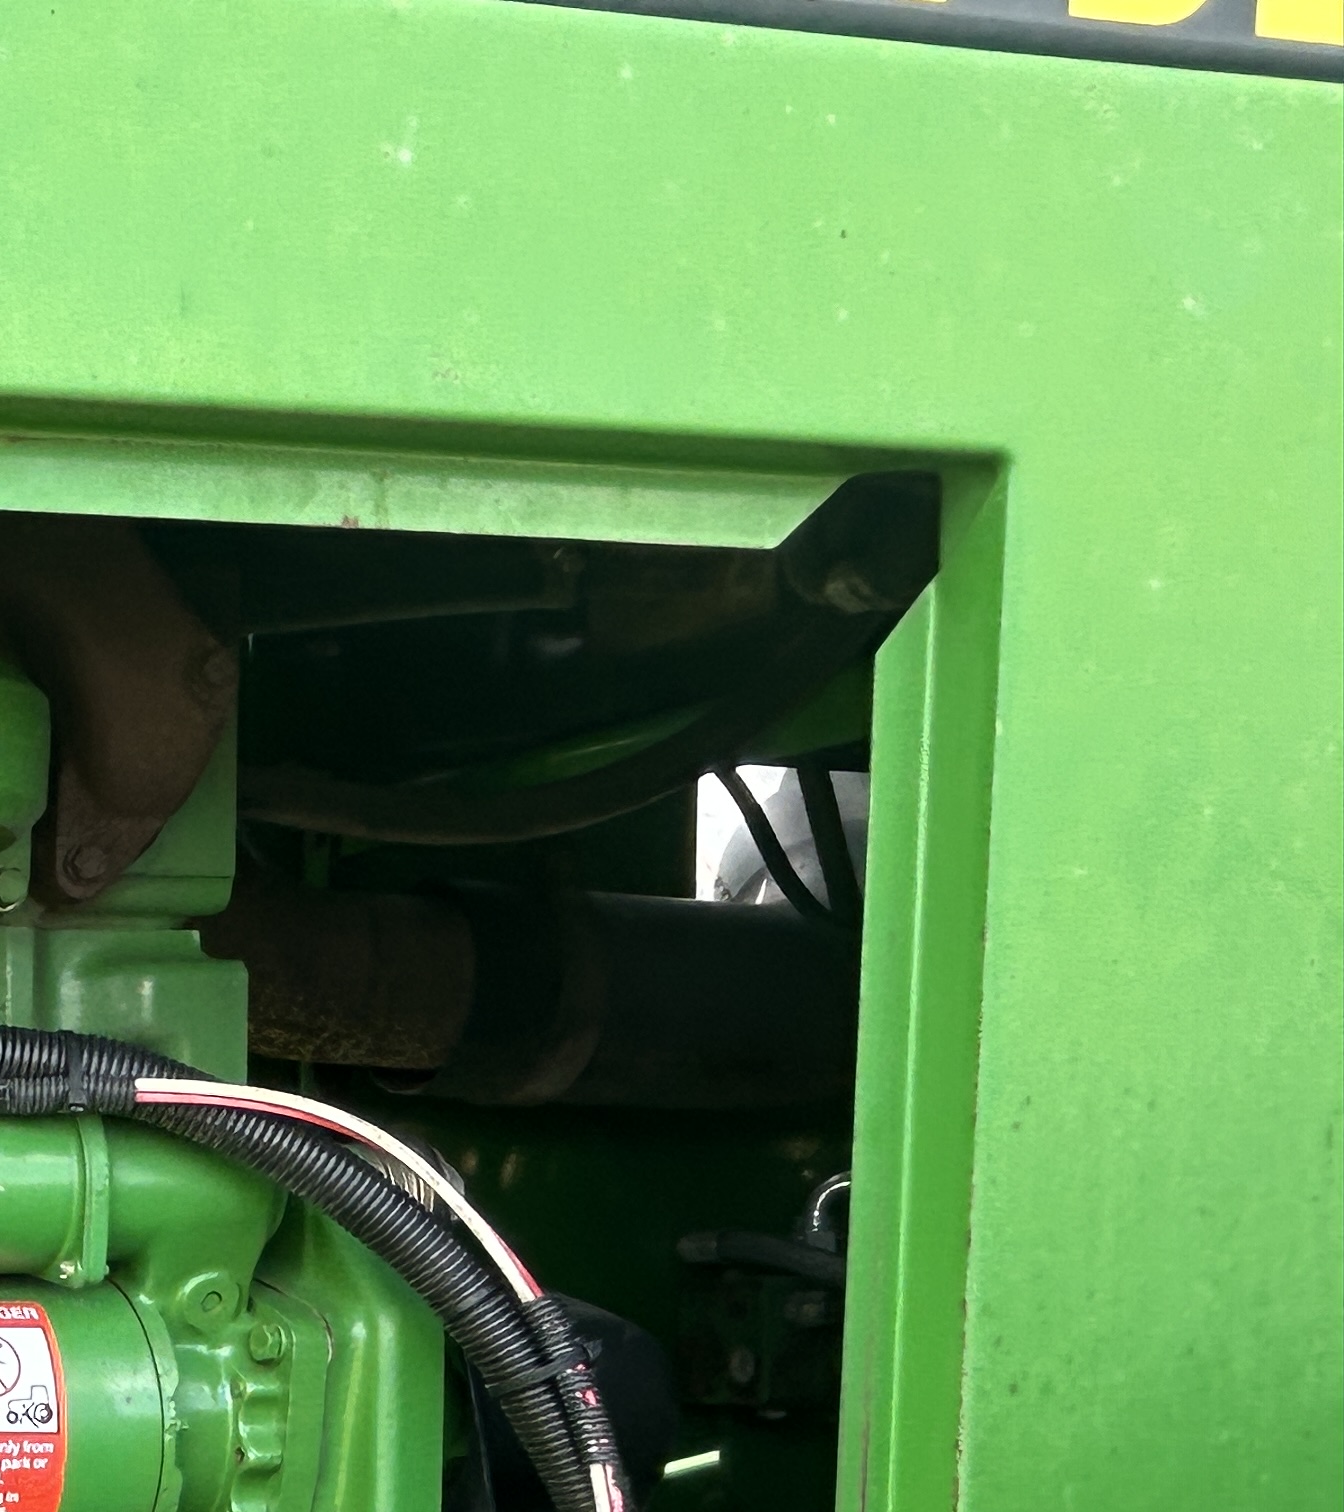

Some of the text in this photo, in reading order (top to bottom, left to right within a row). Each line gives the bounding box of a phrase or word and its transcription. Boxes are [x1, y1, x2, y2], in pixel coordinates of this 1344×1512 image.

[22, 1440, 54, 1454] from
[0, 1457, 31, 1472] park
[32, 1458, 49, 1470] or
[5, 1491, 20, 1503] in
